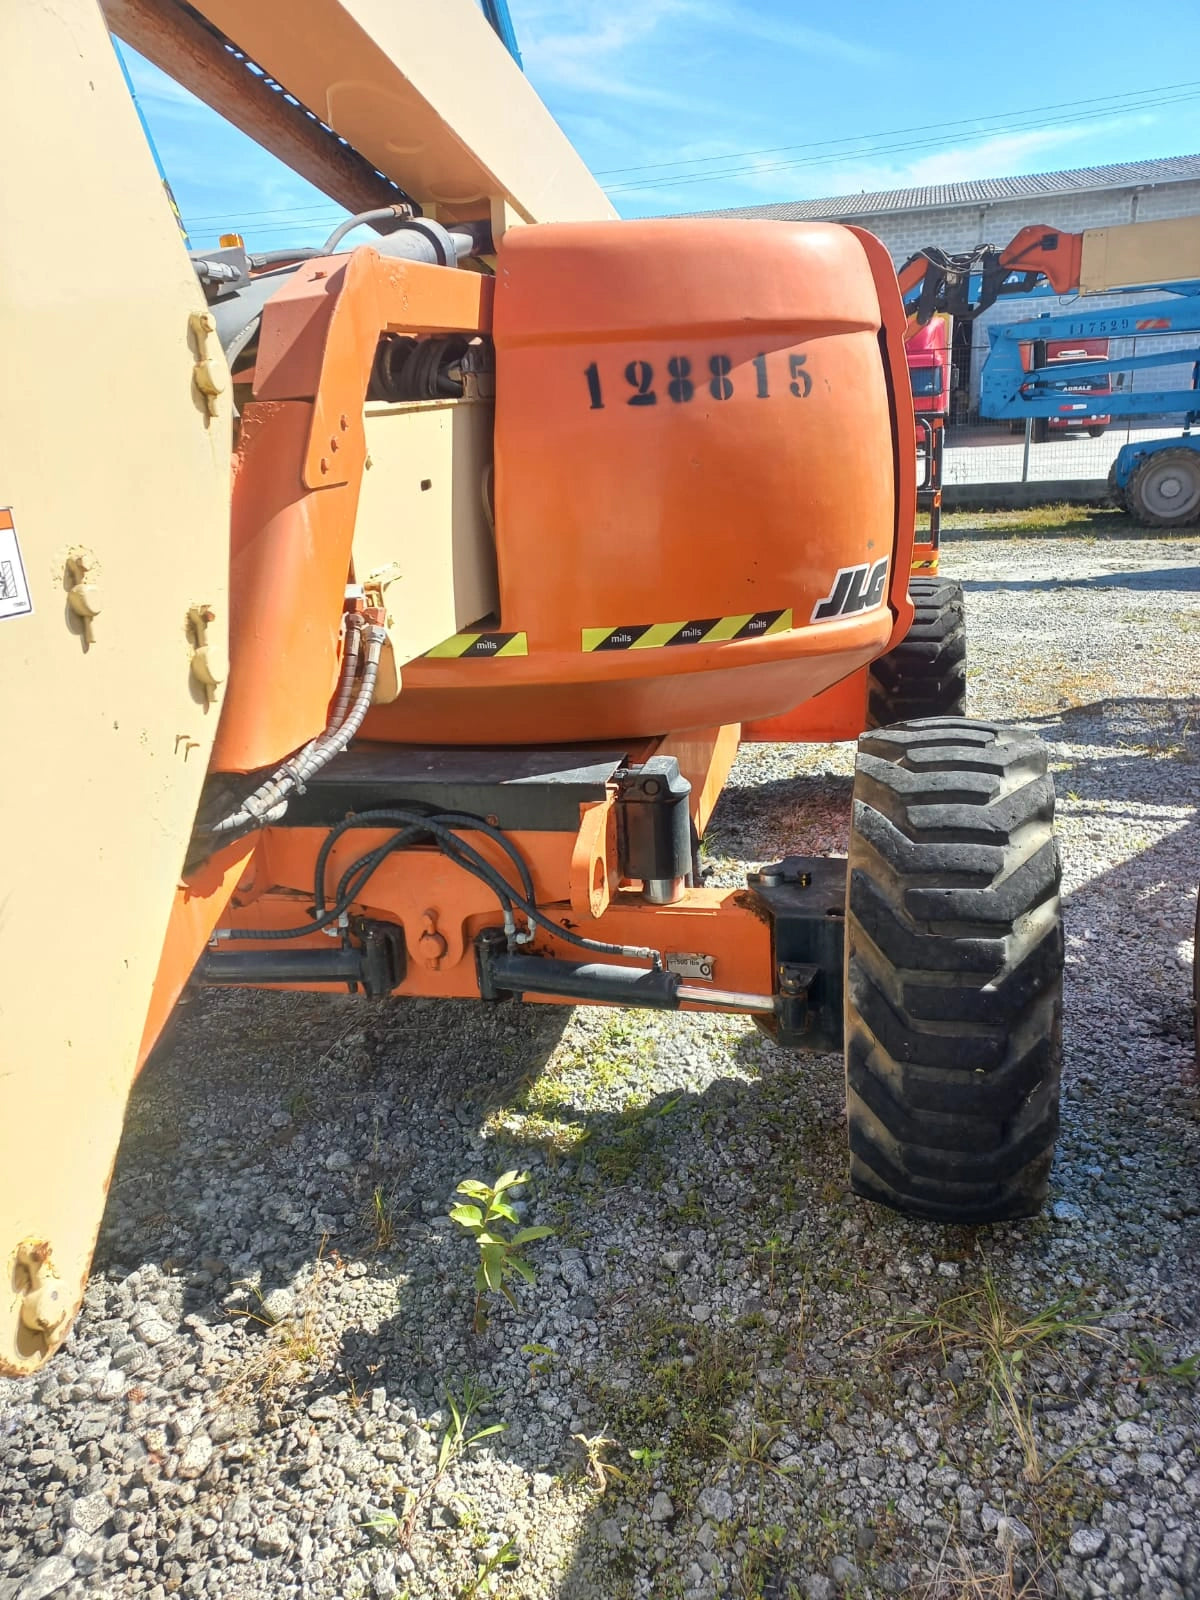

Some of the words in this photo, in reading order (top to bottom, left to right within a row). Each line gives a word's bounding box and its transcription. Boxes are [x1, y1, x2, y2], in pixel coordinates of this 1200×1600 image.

[1069, 319, 1129, 335] 117529
[584, 352, 812, 409] 128815
[811, 556, 888, 622] JLG
[748, 620, 767, 629] mills
[682, 628, 702, 637] mills
[611, 634, 632, 643] mills
[476, 640, 497, 650] mills
